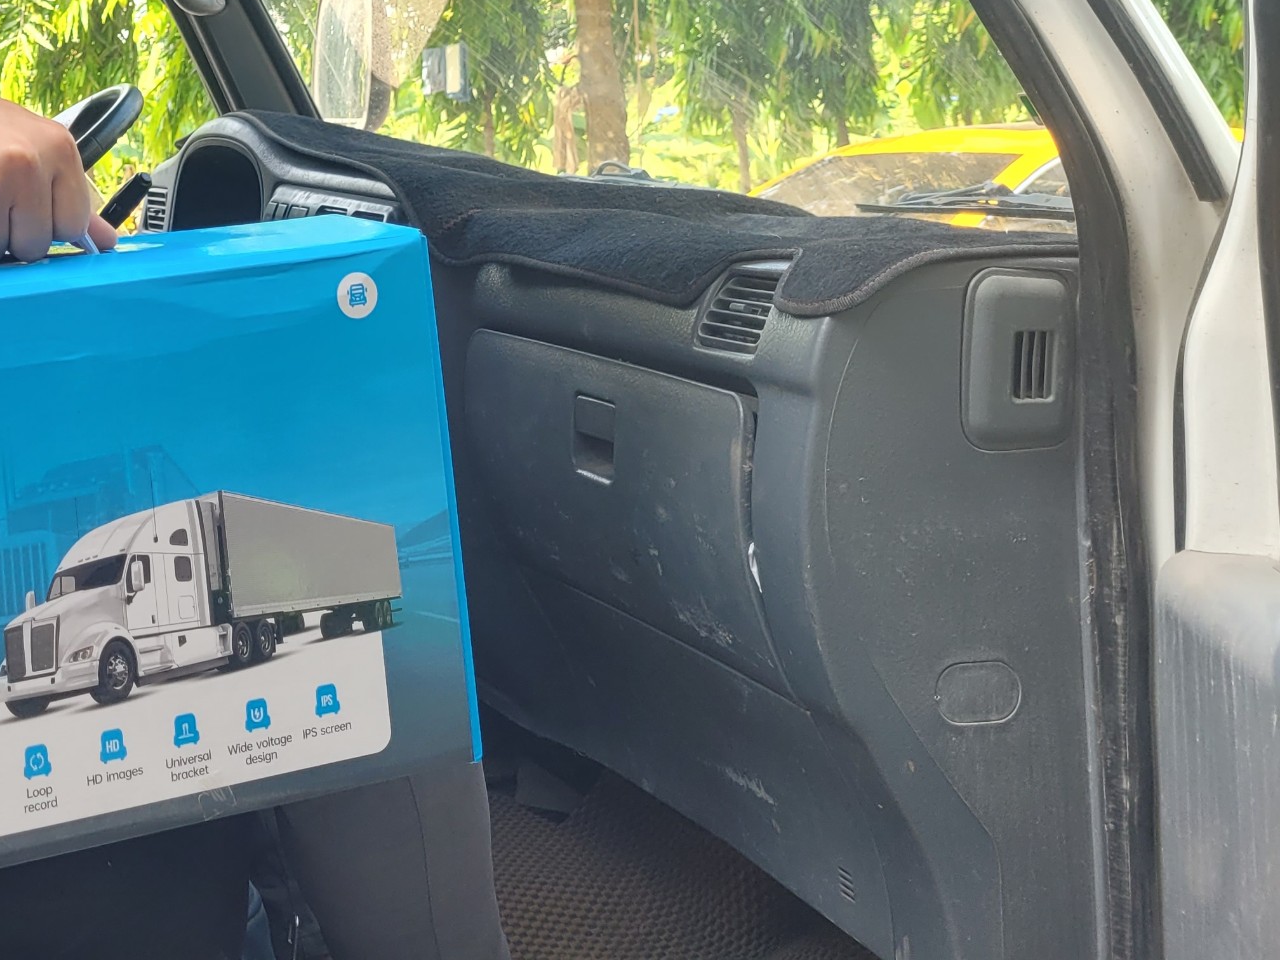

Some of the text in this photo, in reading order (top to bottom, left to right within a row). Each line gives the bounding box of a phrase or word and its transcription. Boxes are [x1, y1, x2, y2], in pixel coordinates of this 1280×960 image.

[320, 694, 334, 708] IPS
[302, 720, 352, 740] IPS screen
[105, 739, 120, 753] HD
[227, 733, 293, 756] Wide voltage
[165, 749, 212, 770] Universal
[245, 750, 278, 766] design
[86, 765, 144, 787] HD images
[170, 764, 210, 783] bracket
[26, 784, 53, 801] Loop
[24, 797, 58, 814] record
